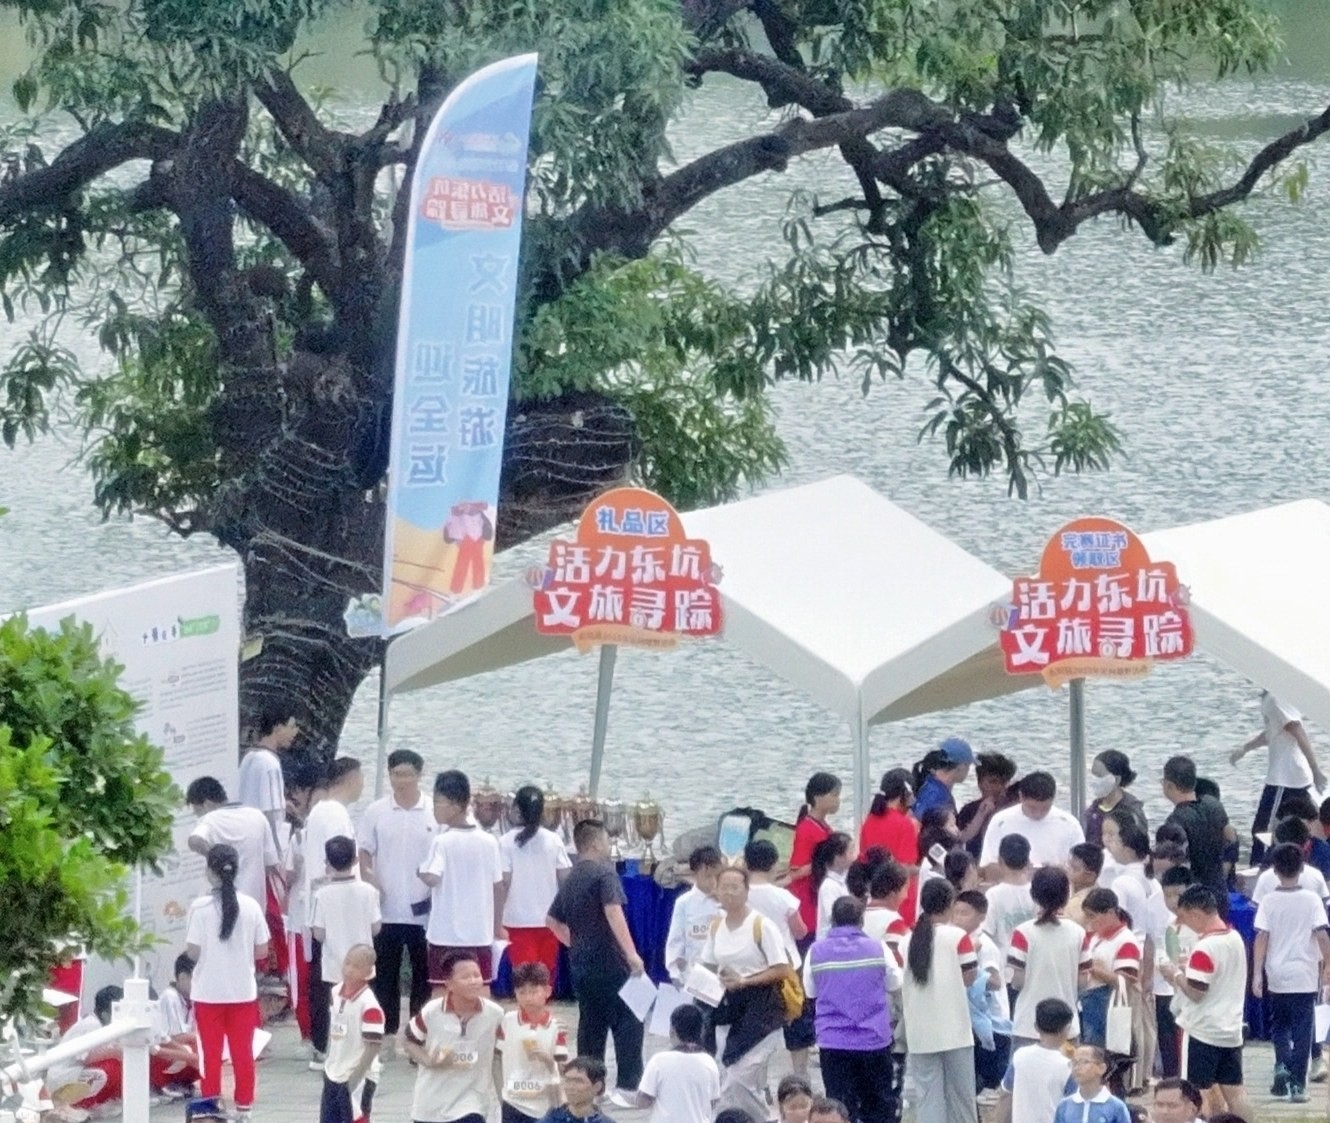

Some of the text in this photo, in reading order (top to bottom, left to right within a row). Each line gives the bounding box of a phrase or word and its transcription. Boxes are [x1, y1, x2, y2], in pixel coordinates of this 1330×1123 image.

[596, 506, 669, 537] 礼品区
[1062, 531, 1128, 550] 完赛证书
[554, 543, 702, 584] 活力东坑
[543, 585, 713, 631] 文旅寻踪
[1018, 568, 1168, 619] 活力东坑
[1011, 611, 1184, 666] 文旅寻踪
